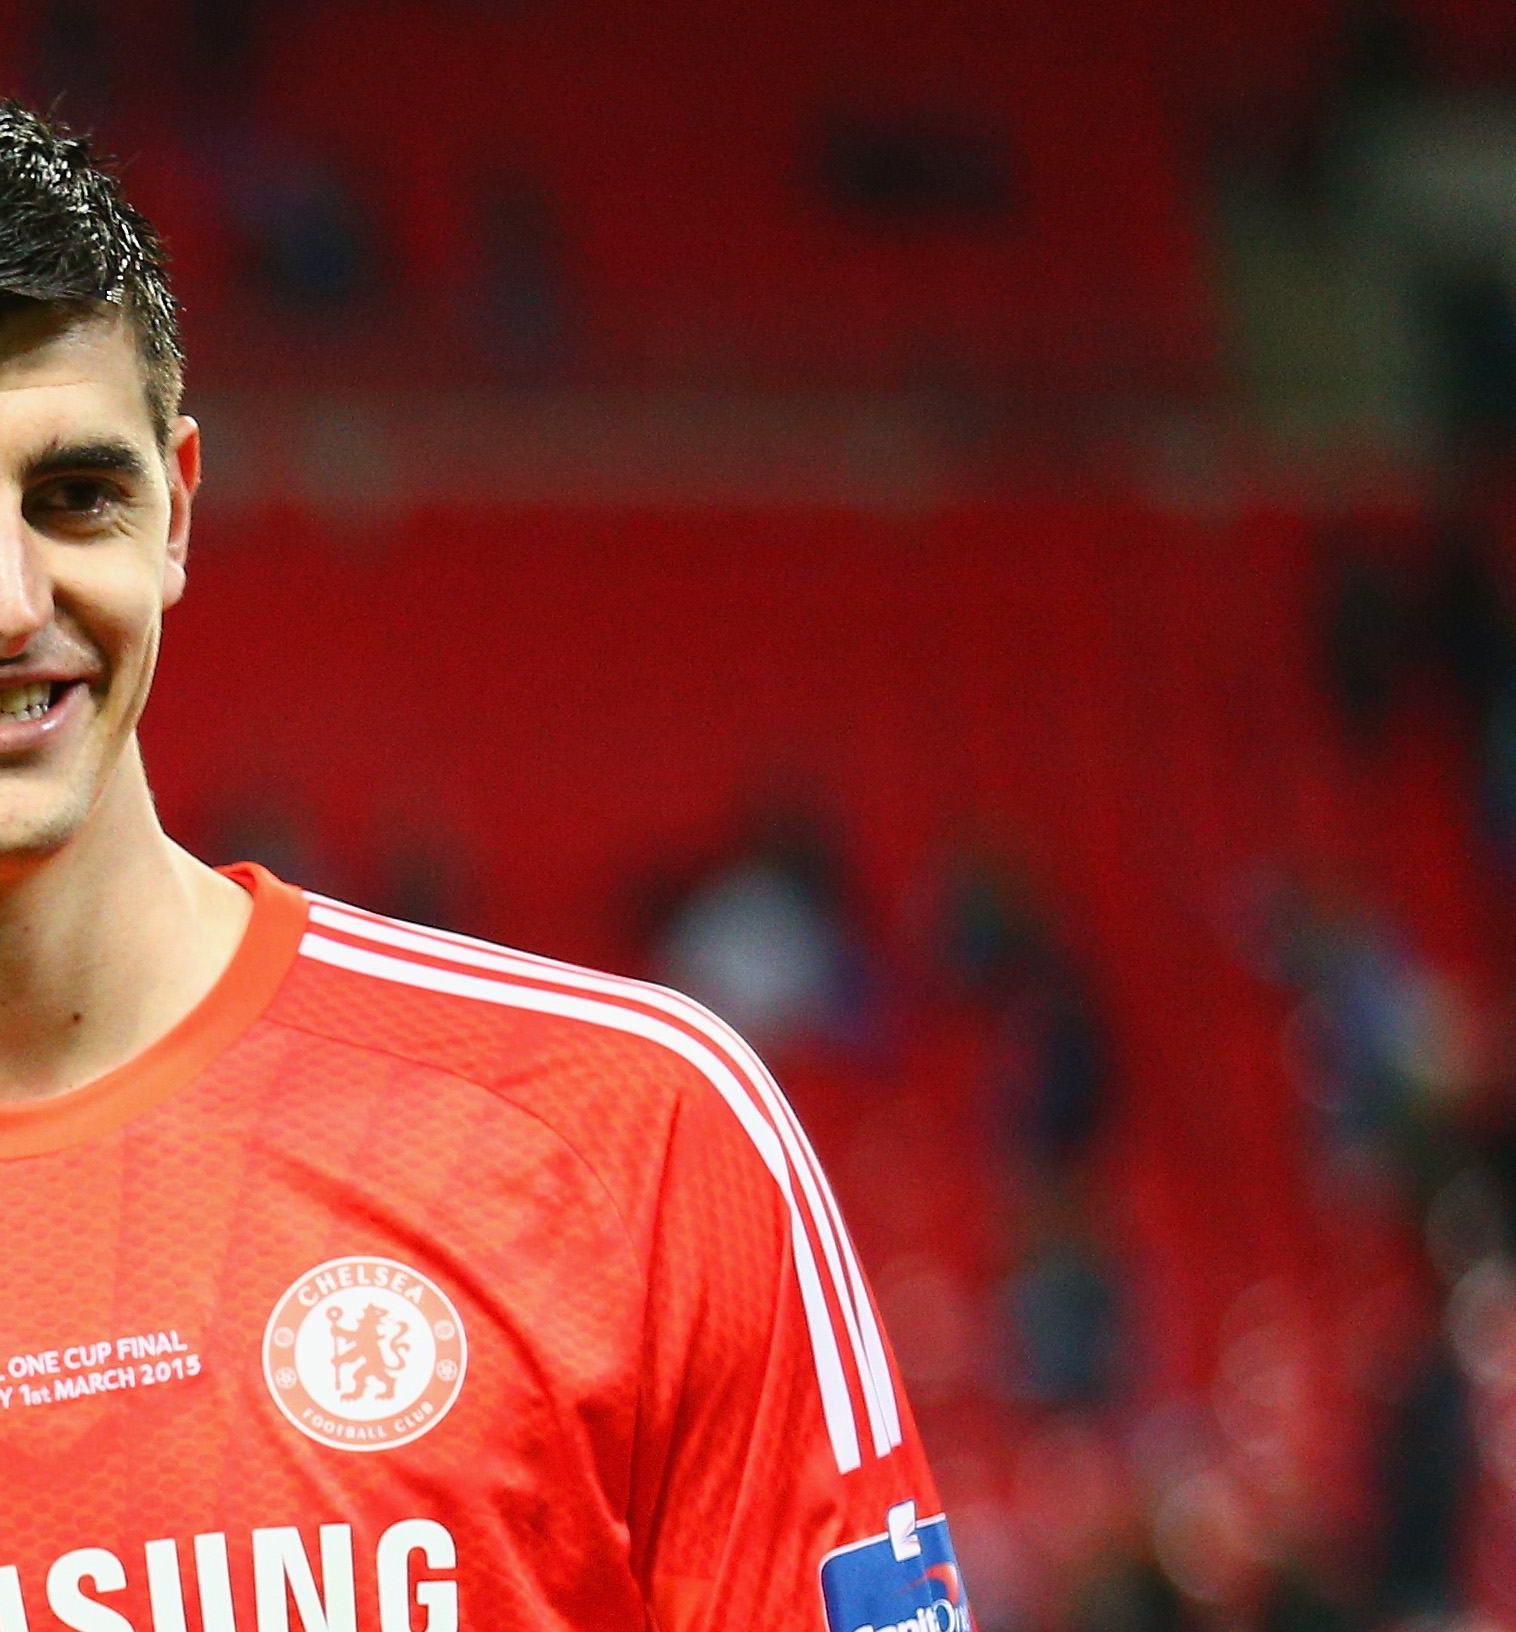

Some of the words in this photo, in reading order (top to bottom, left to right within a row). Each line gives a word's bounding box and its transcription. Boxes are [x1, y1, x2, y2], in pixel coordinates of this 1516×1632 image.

[297, 1264, 425, 1307] CHELSEA
[7, 1350, 62, 1379] ONE
[63, 1341, 112, 1370] CUP
[116, 1329, 188, 1361] FINAL
[18, 1383, 52, 1407] 1st
[54, 1366, 136, 1401] MARCH
[139, 1353, 202, 1386] 2015
[301, 1406, 388, 1440] FOOTBALL
[393, 1400, 435, 1434] CLUB
